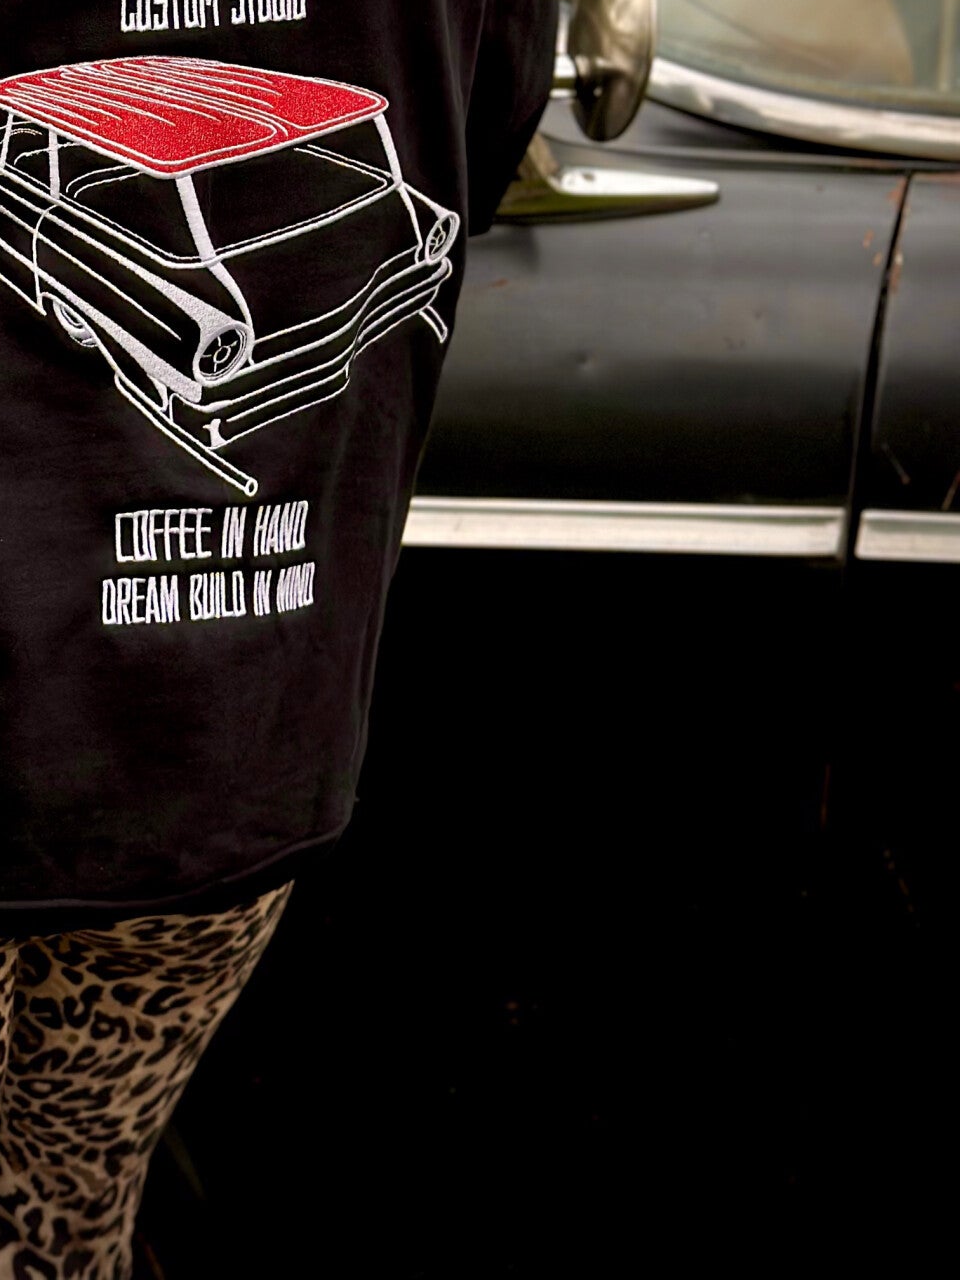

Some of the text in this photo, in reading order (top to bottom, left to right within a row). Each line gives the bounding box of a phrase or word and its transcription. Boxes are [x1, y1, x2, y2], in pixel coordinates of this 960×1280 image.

[114, 500, 309, 563] COFFEE IN HAND
[101, 561, 316, 625] DREAM BUILD IN MIND
